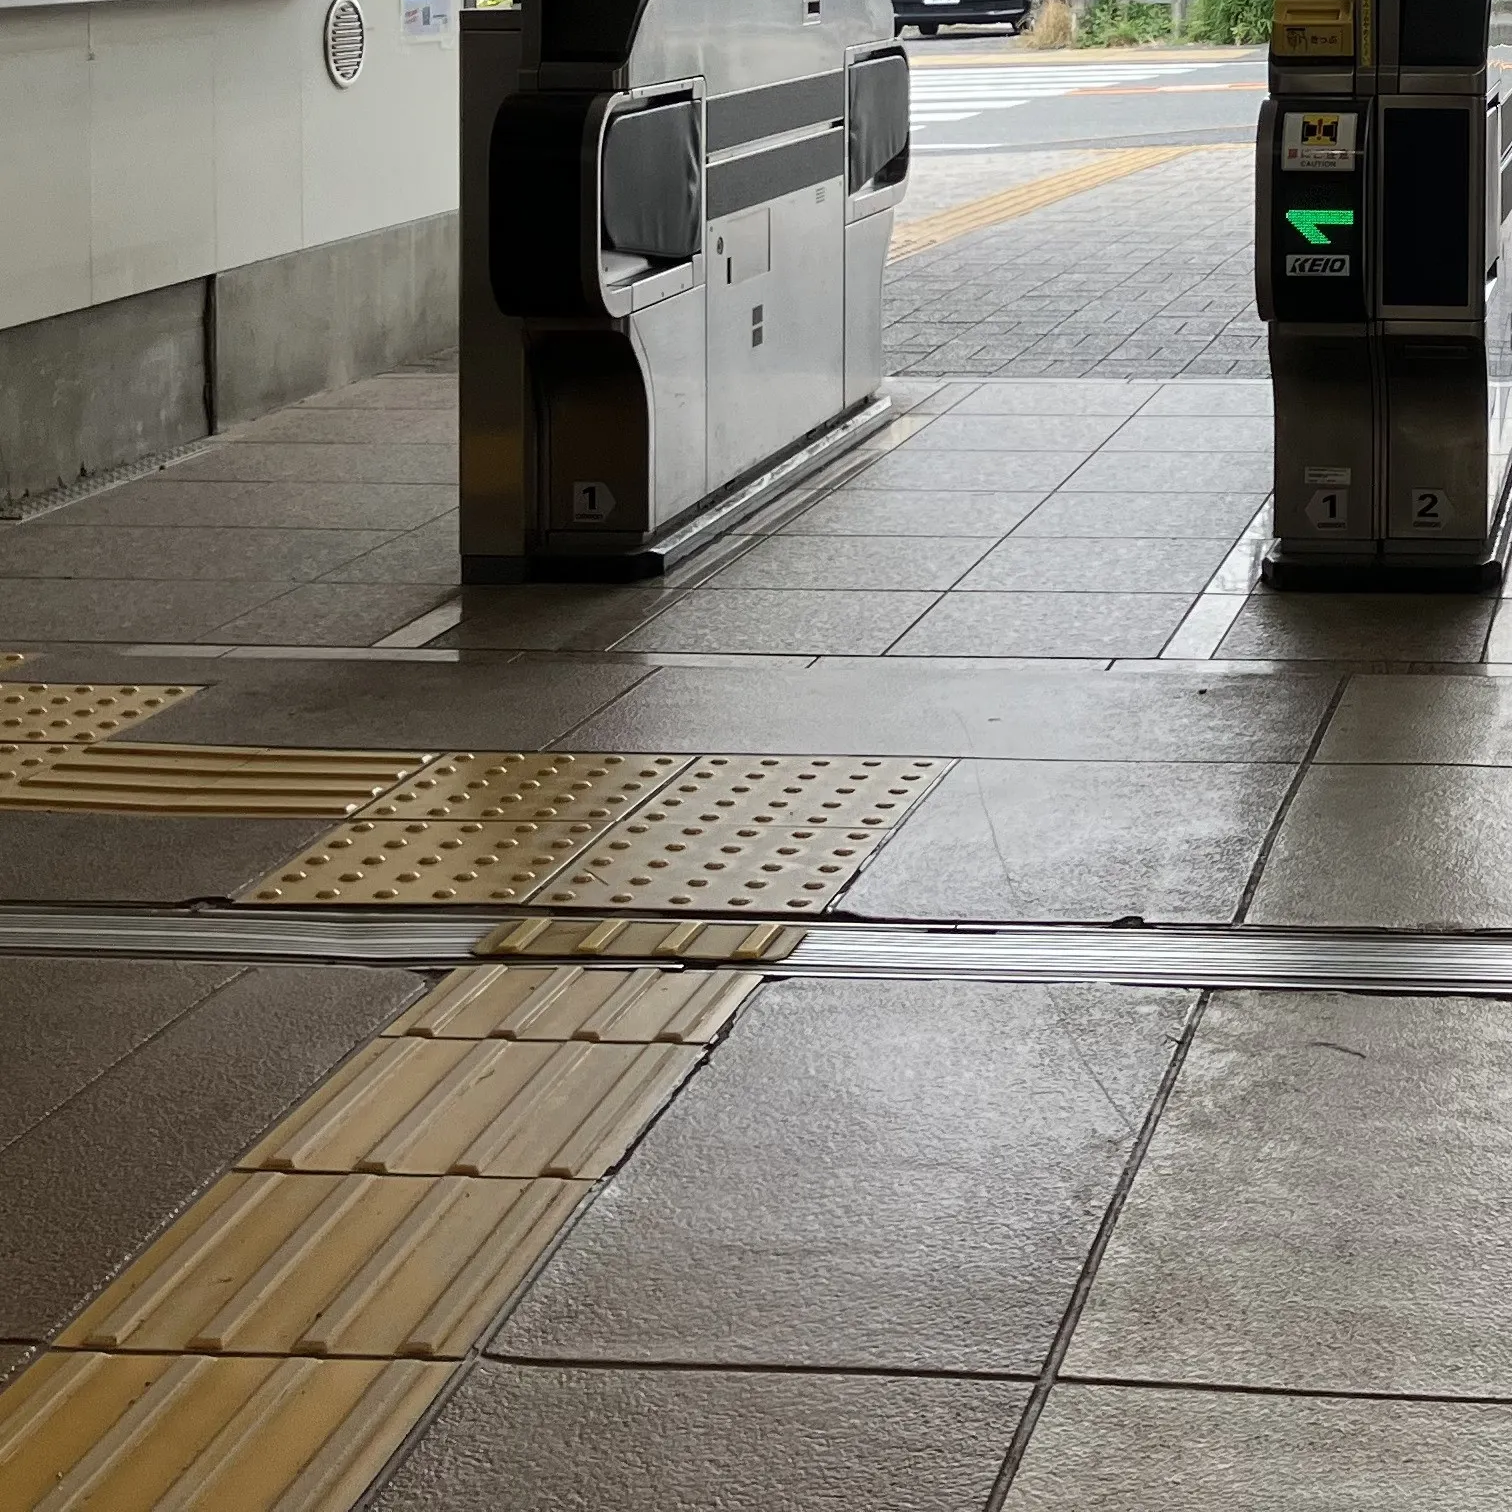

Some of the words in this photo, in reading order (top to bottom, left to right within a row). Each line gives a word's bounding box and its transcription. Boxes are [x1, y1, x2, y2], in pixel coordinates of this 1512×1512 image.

[1300, 160, 1337, 168] CAUTION
[1290, 257, 1346, 273] KEIO
[582, 486, 597, 510] 1
[1322, 494, 1337, 519] 1
[1417, 493, 1439, 518] 2
